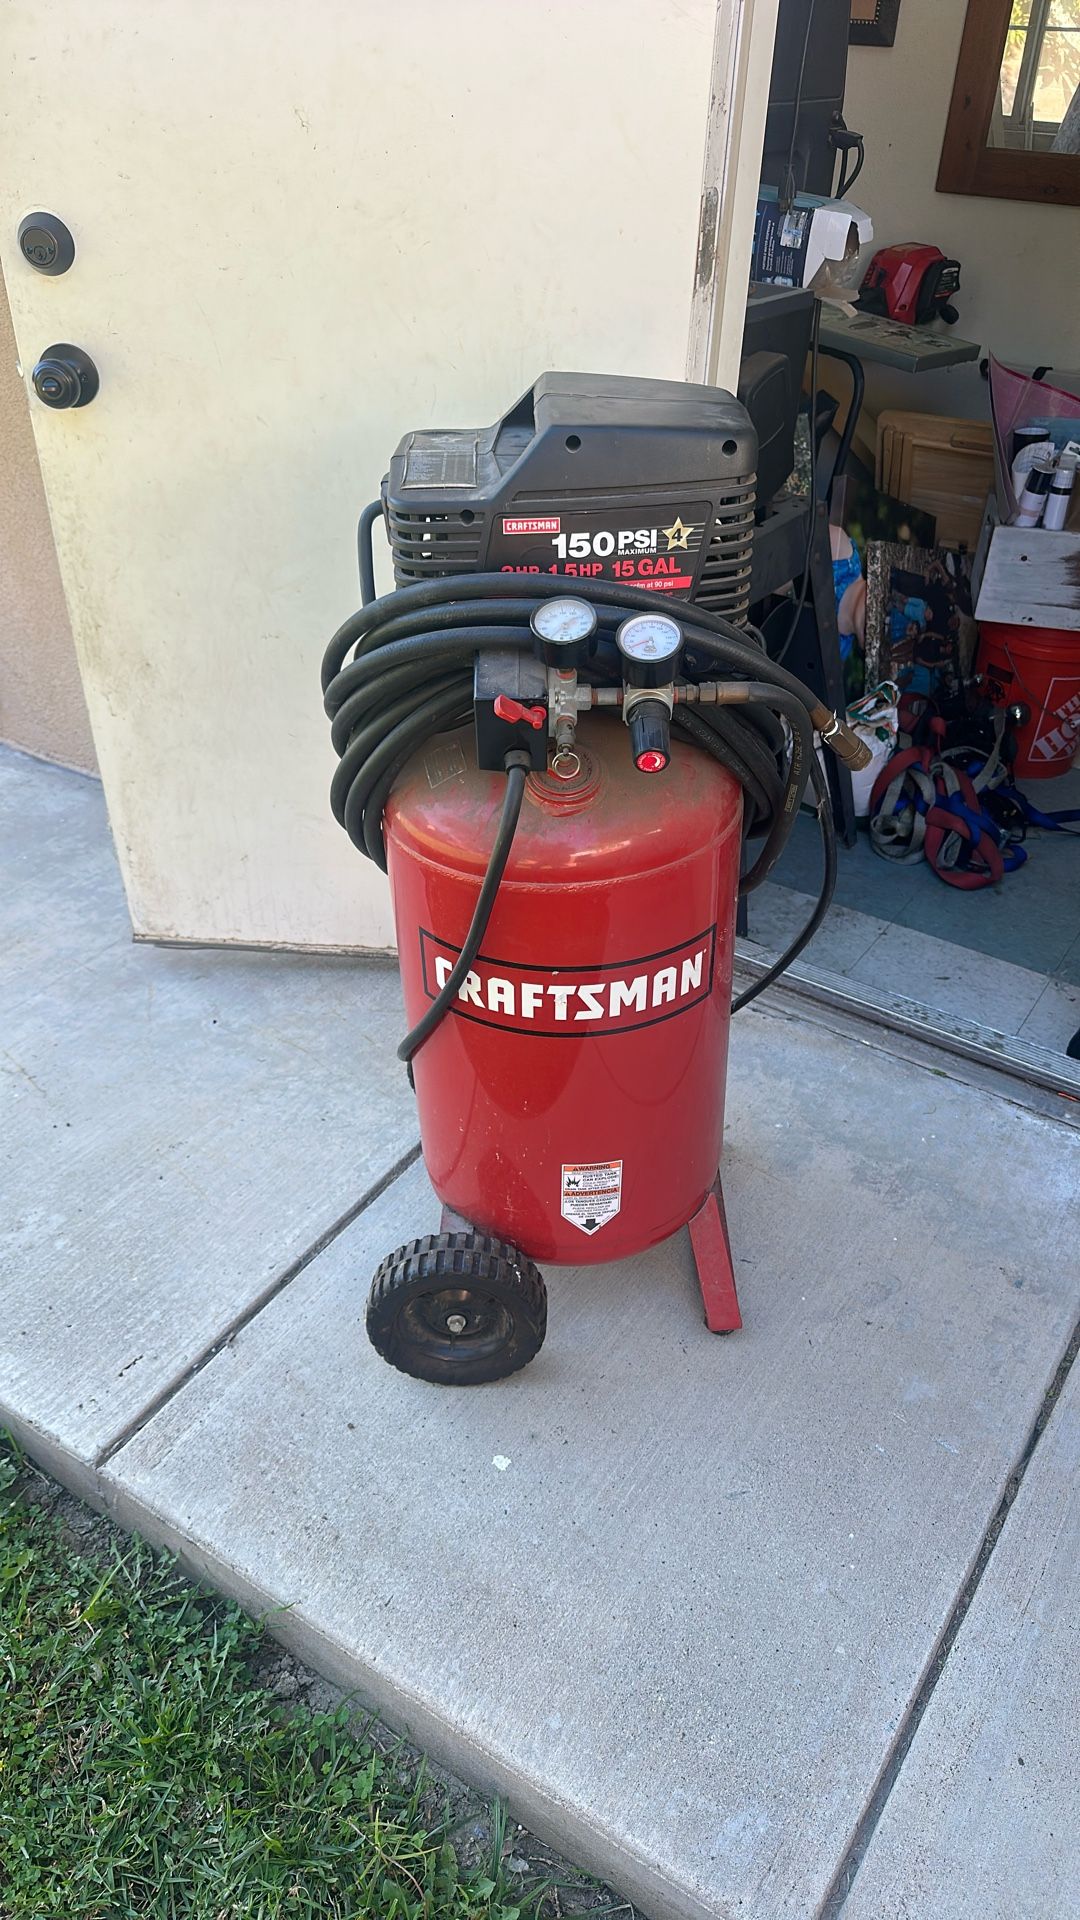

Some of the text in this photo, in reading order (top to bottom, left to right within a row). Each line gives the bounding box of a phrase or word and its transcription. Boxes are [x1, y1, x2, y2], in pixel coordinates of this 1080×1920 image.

[506, 521, 556, 531] CRAFTSMAN
[672, 528, 683, 542] 4
[552, 529, 657, 559] 150 PSI
[663, 580, 674, 588] psi
[434, 951, 704, 1021] CRAFTSMAN
[571, 1188, 618, 1197] ADVERTENCIA
